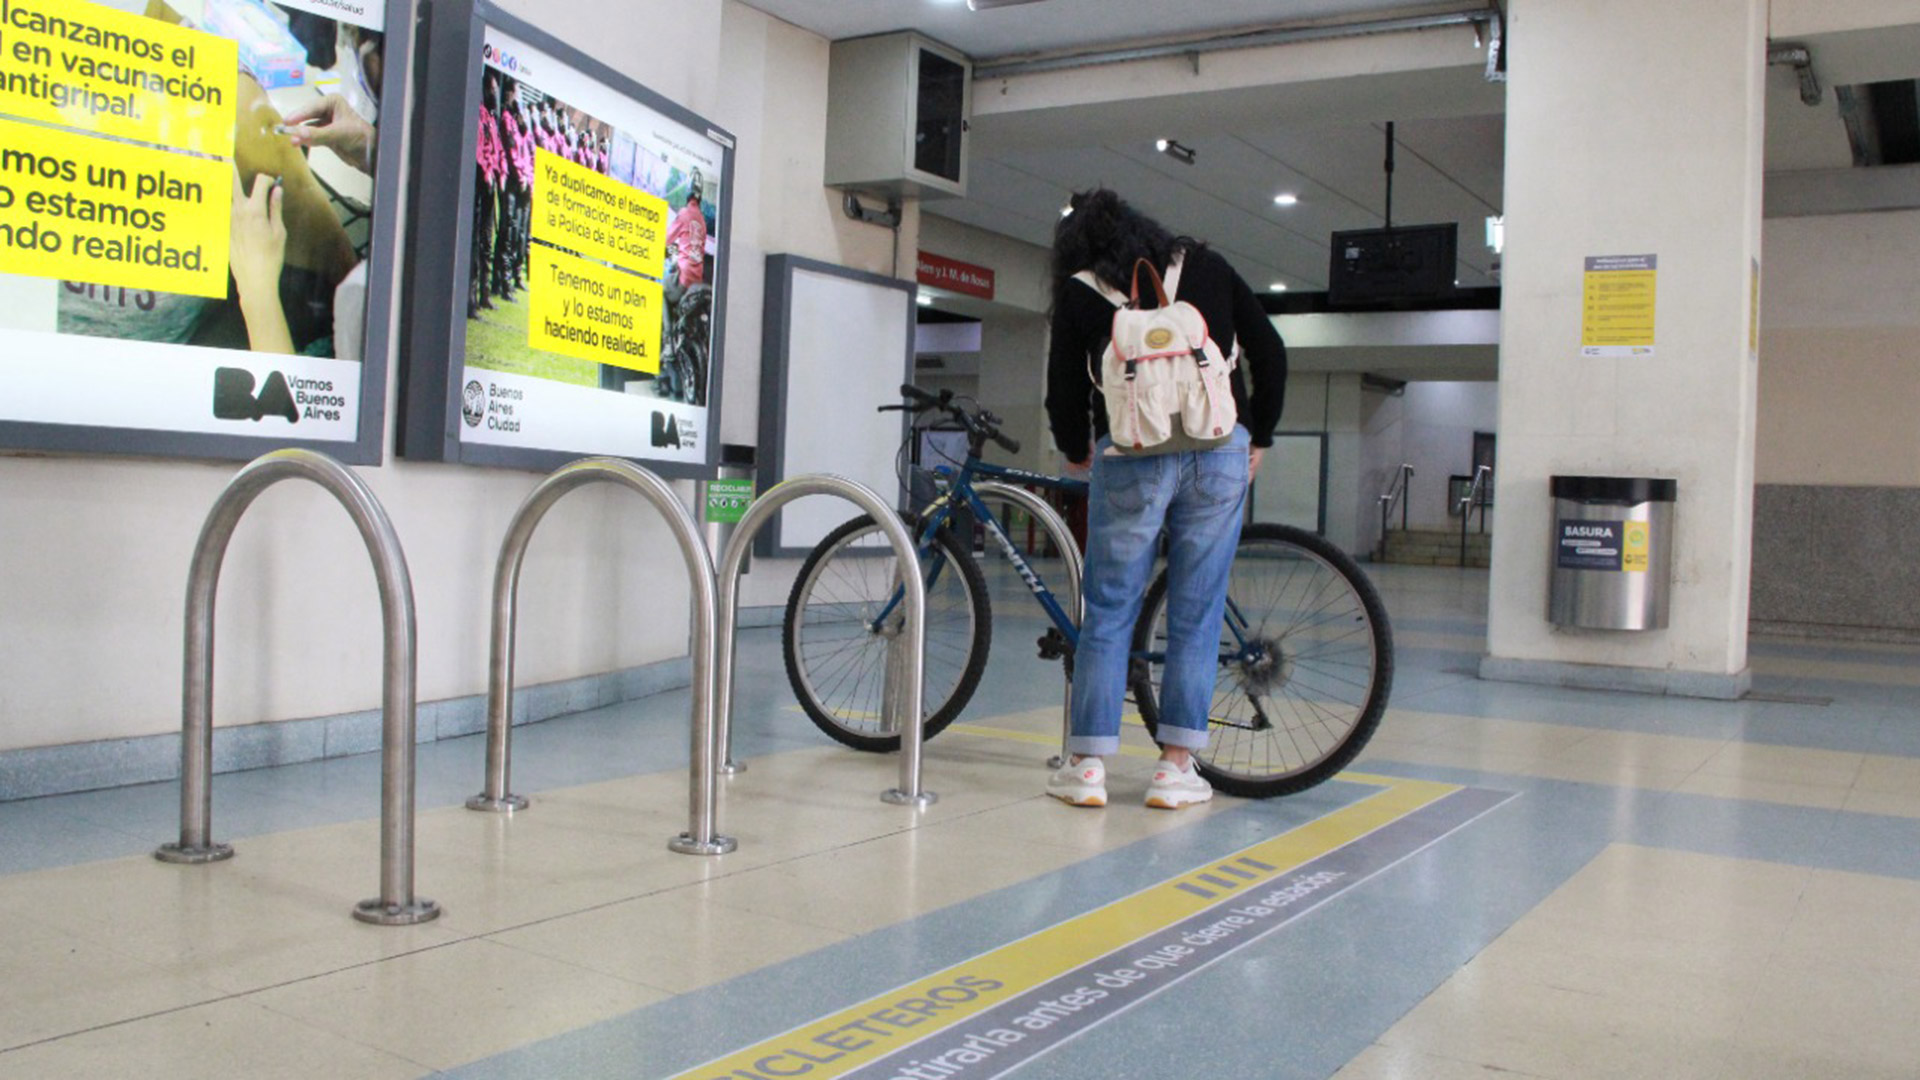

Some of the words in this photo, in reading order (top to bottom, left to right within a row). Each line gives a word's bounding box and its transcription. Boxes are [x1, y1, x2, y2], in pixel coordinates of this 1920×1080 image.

[12, 41, 51, 67] en
[61, 52, 222, 106] vacunación
[171, 46, 195, 69] el
[1, 149, 77, 182] mos
[87, 164, 126, 191] un
[136, 170, 202, 203] plan
[545, 164, 558, 183] Ya
[560, 172, 616, 207] duplicamos
[618, 196, 627, 210] el
[628, 198, 660, 223] tiempo
[26, 190, 166, 232] estamos
[547, 190, 560, 206] de
[563, 193, 611, 224] formación
[613, 216, 633, 234] para
[635, 223, 655, 242] toda
[548, 210, 556, 227] la
[593, 227, 605, 244] de
[608, 231, 615, 248] la
[72, 234, 208, 272] realidad.
[550, 263, 604, 298] Tenemos
[607, 285, 621, 301] un
[624, 288, 647, 309] plan
[563, 299, 570, 318] y
[573, 297, 584, 317] lo
[587, 305, 633, 331] estamos
[545, 315, 599, 347] haciendo
[602, 333, 648, 358] realidad.
[213, 366, 299, 424] BA
[288, 374, 333, 391] Vamos
[296, 391, 345, 407] Buenos
[489, 383, 523, 401] Buenos
[489, 399, 514, 416] Aires
[304, 407, 341, 421] Aires
[488, 415, 521, 433] Ciudad
[651, 410, 681, 451] BA
[1565, 525, 1613, 538] BASURA
[1012, 986, 1109, 1030] antes
[1093, 968, 1146, 988] de
[1133, 944, 1195, 967] que
[1182, 914, 1255, 946] cierre
[1230, 904, 1275, 918] la
